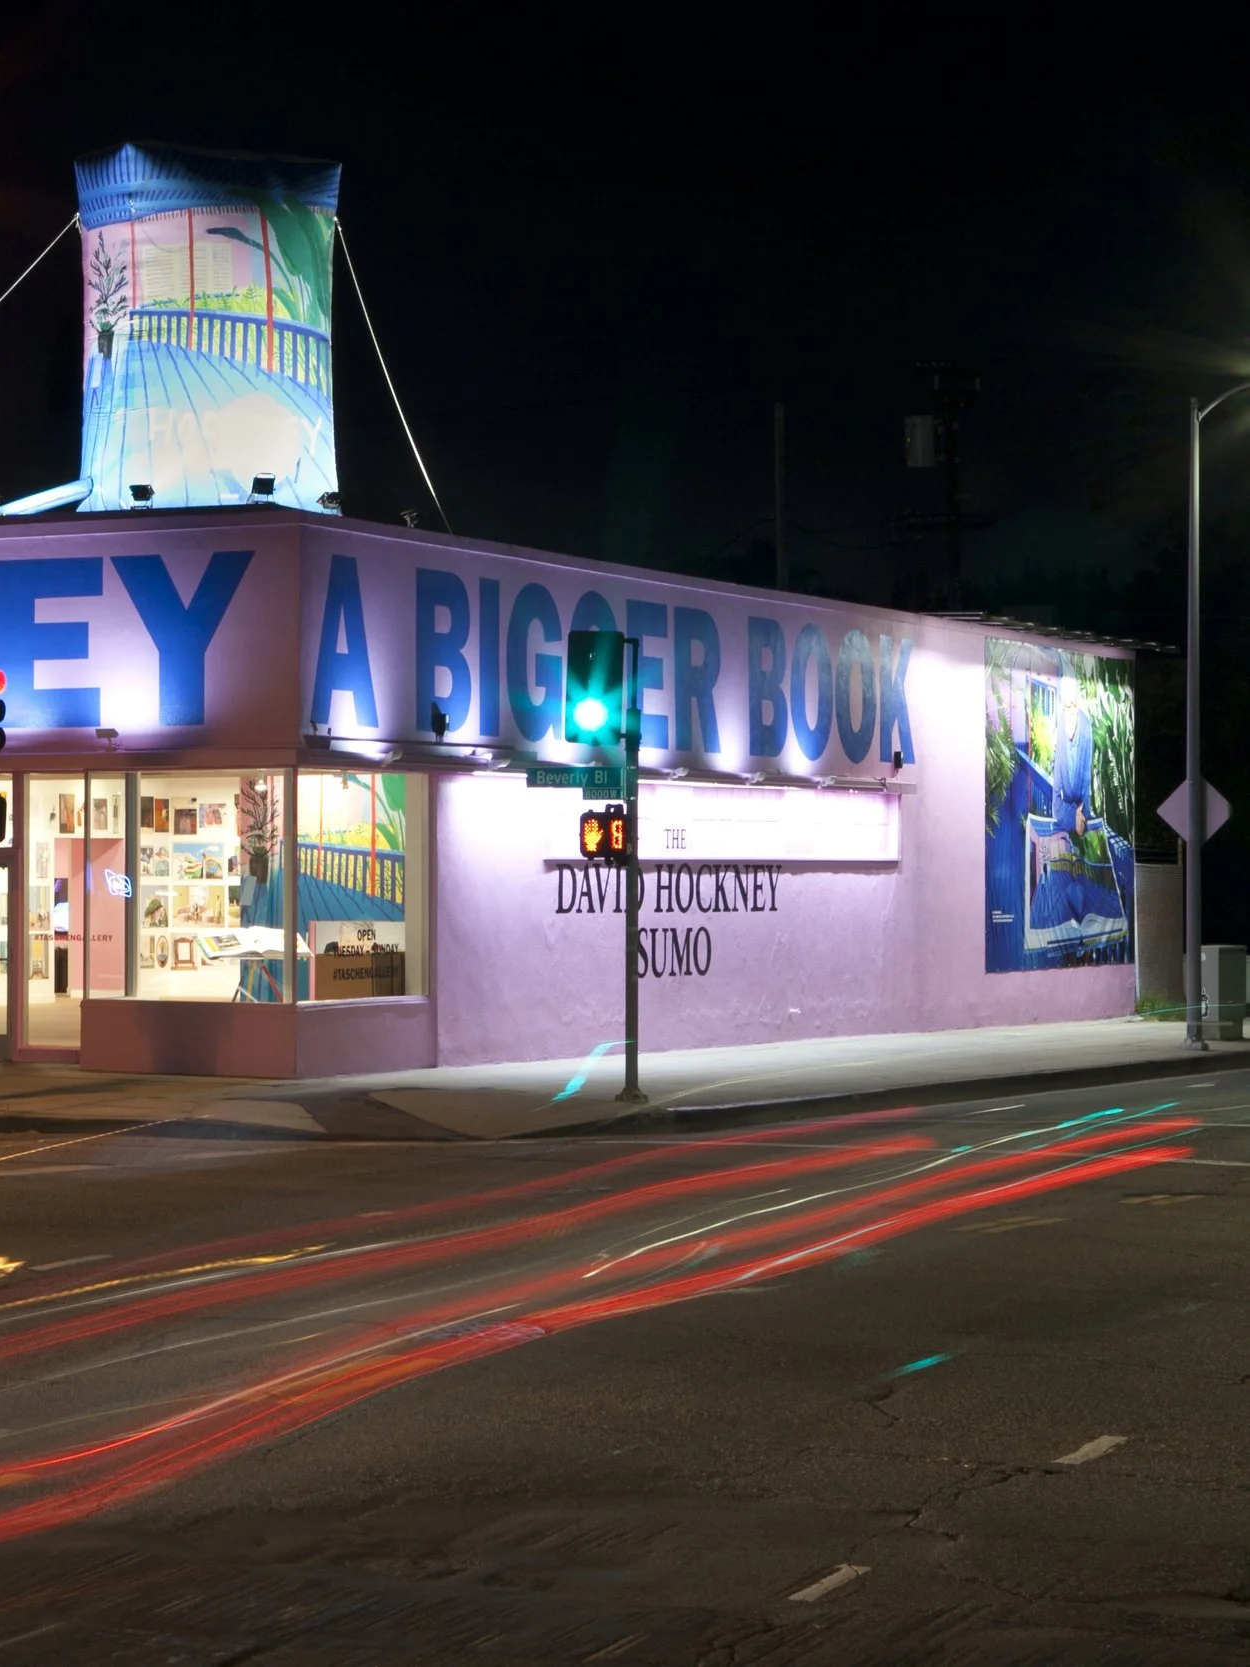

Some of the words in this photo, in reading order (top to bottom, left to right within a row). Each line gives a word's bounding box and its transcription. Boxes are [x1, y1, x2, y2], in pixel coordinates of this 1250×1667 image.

[310, 553, 380, 729] A
[748, 615, 916, 765] BOOK
[536, 770, 589, 788] Beverly
[594, 770, 608, 784] Bl
[664, 828, 687, 850] THE
[653, 863, 783, 914] HOCKNEY
[356, 929, 377, 941] OPEN
[333, 944, 365, 958] TUESDAY
[371, 943, 399, 956] SUNDAY
[636, 926, 713, 979] SUMO
